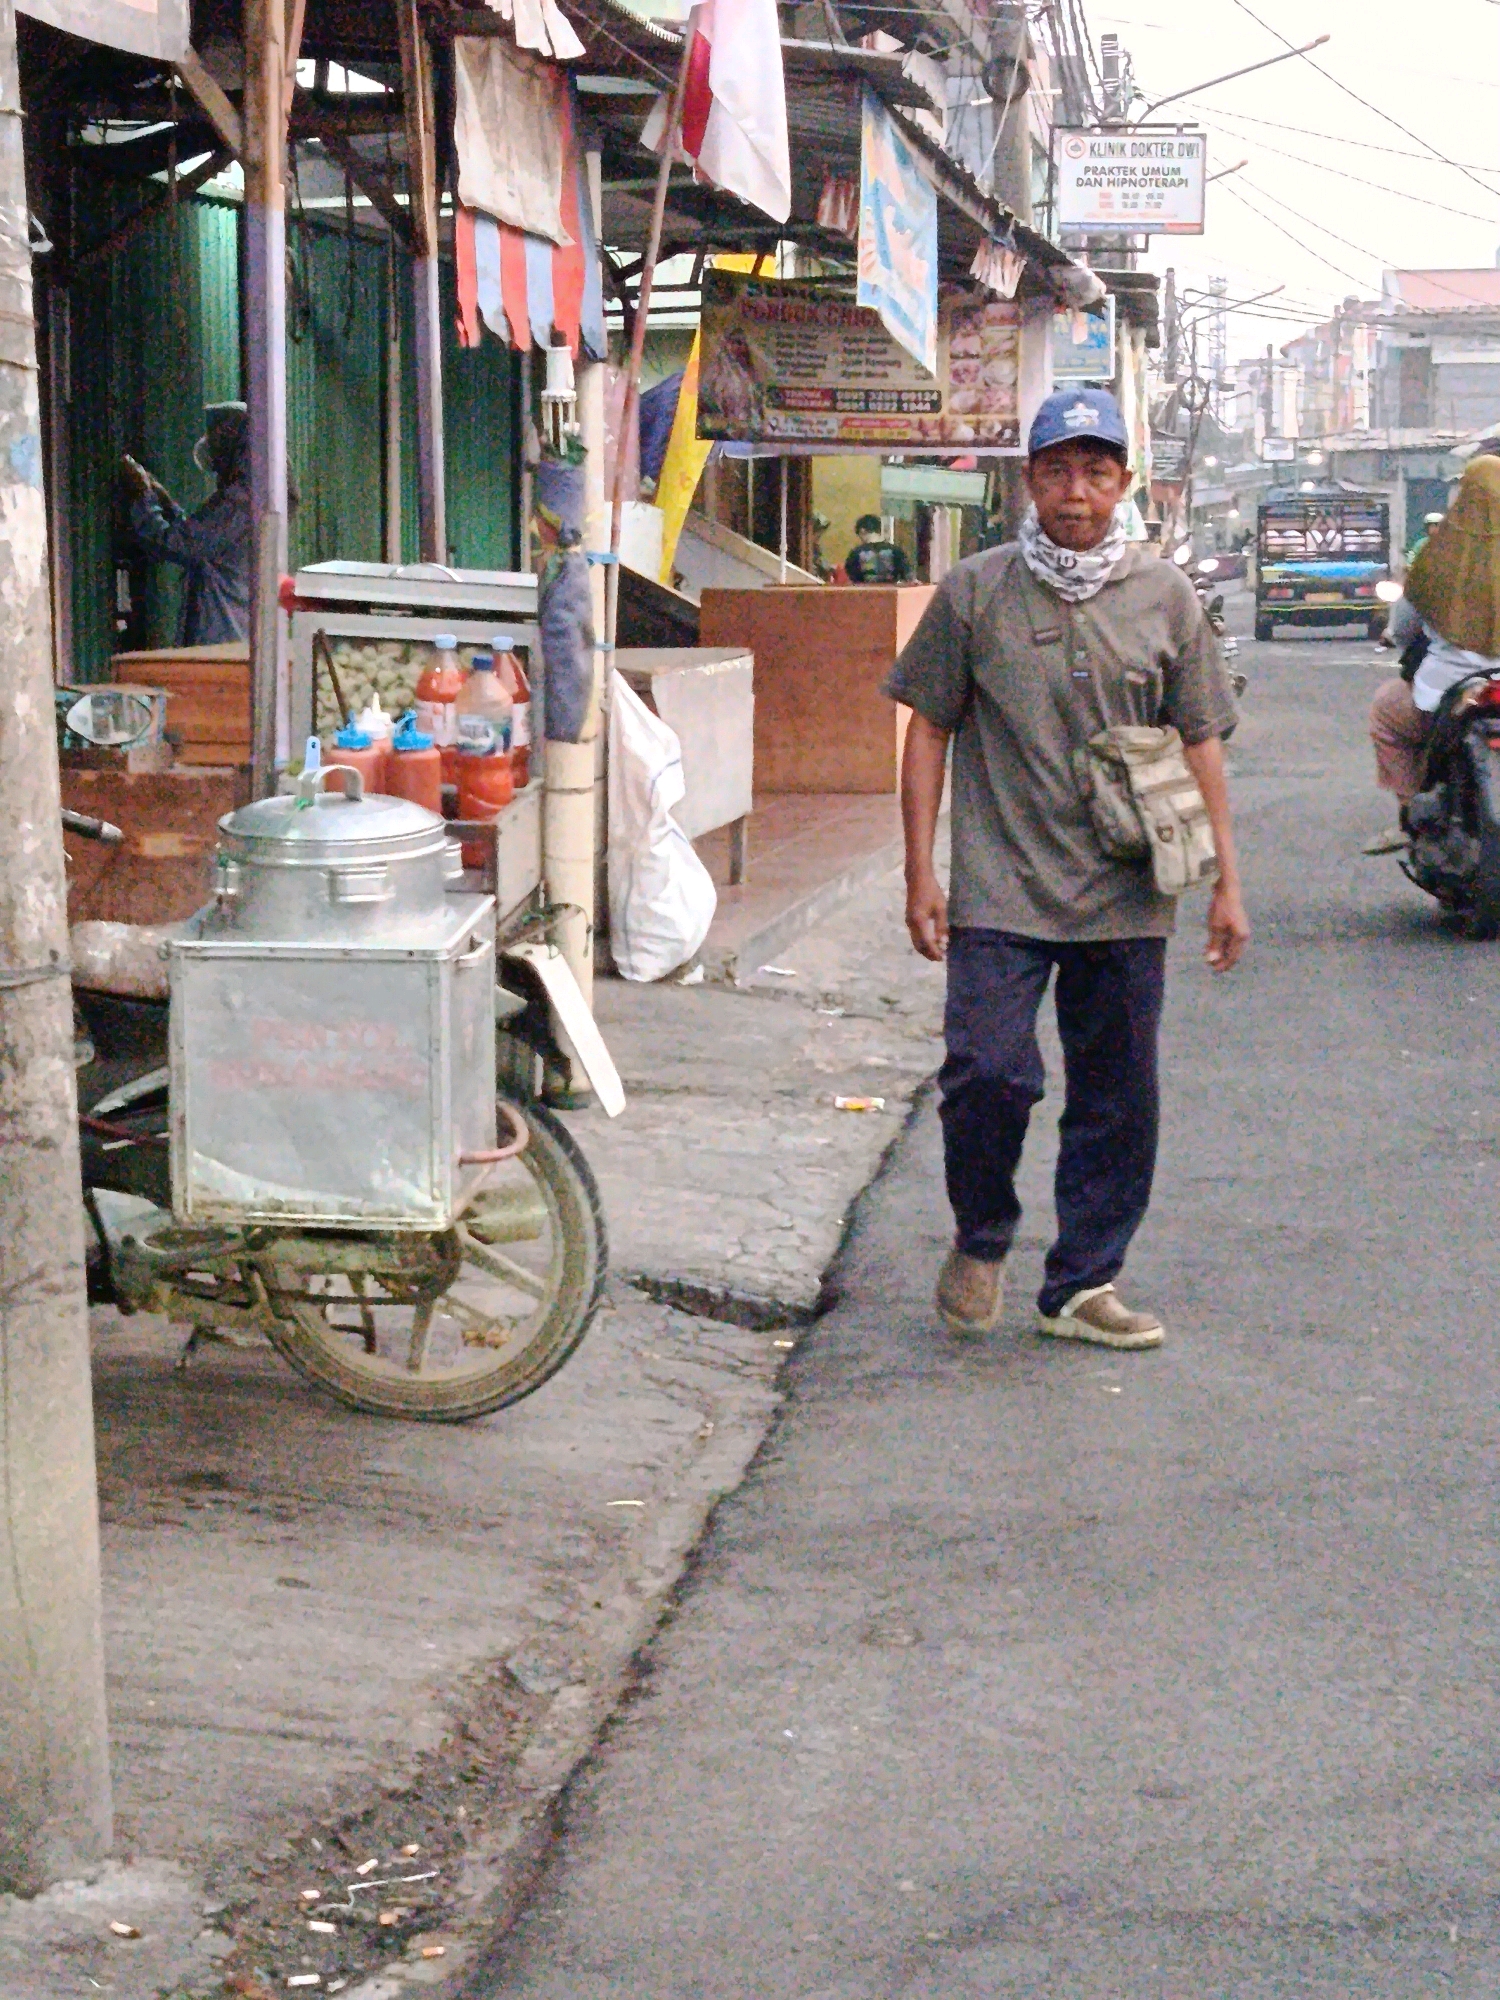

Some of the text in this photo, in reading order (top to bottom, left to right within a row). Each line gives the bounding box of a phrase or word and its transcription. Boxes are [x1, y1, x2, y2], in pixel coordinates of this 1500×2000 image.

[1090, 142, 1200, 157] KLINIK DOKTER DWI
[1084, 166, 1181, 176] PRAKTEK UMUM
[1076, 178, 1189, 188] DAN HIPNOTERAPI
